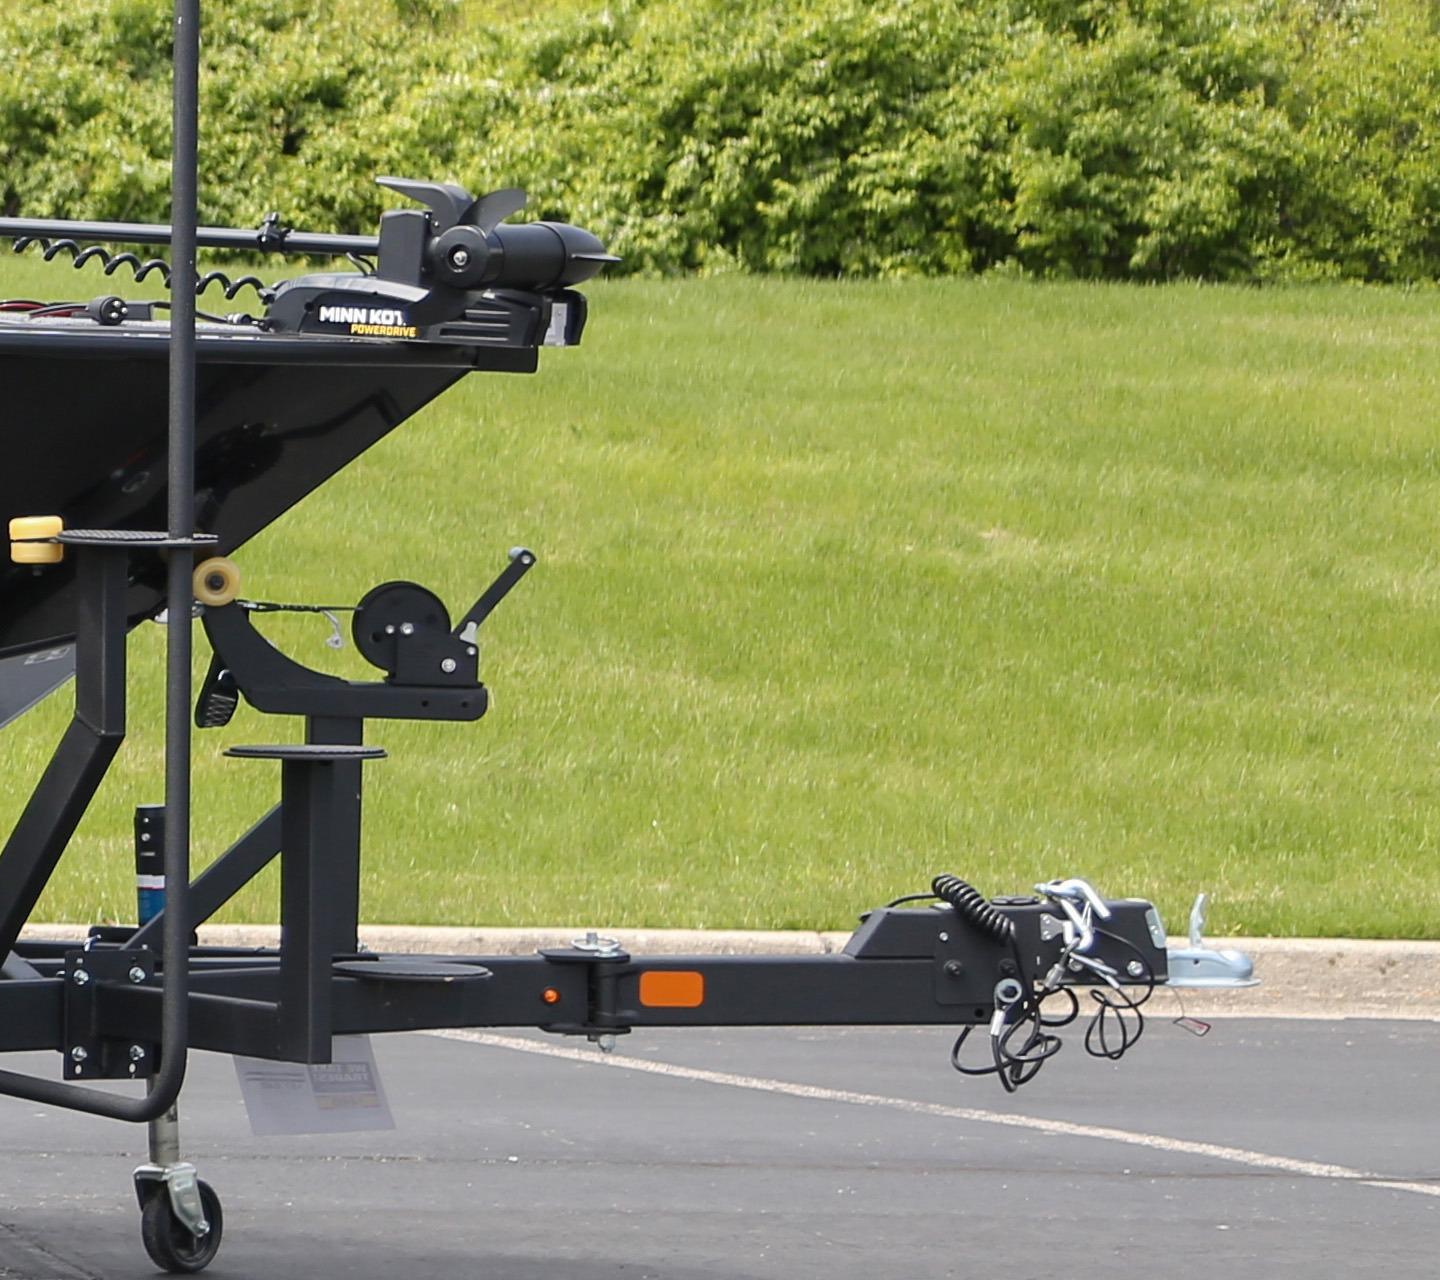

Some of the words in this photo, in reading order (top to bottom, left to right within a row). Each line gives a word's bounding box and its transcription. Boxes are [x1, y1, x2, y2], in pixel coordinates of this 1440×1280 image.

[319, 306, 367, 324] MINN
[369, 309, 407, 326] KOT
[350, 323, 417, 337] POWERDRIVE
